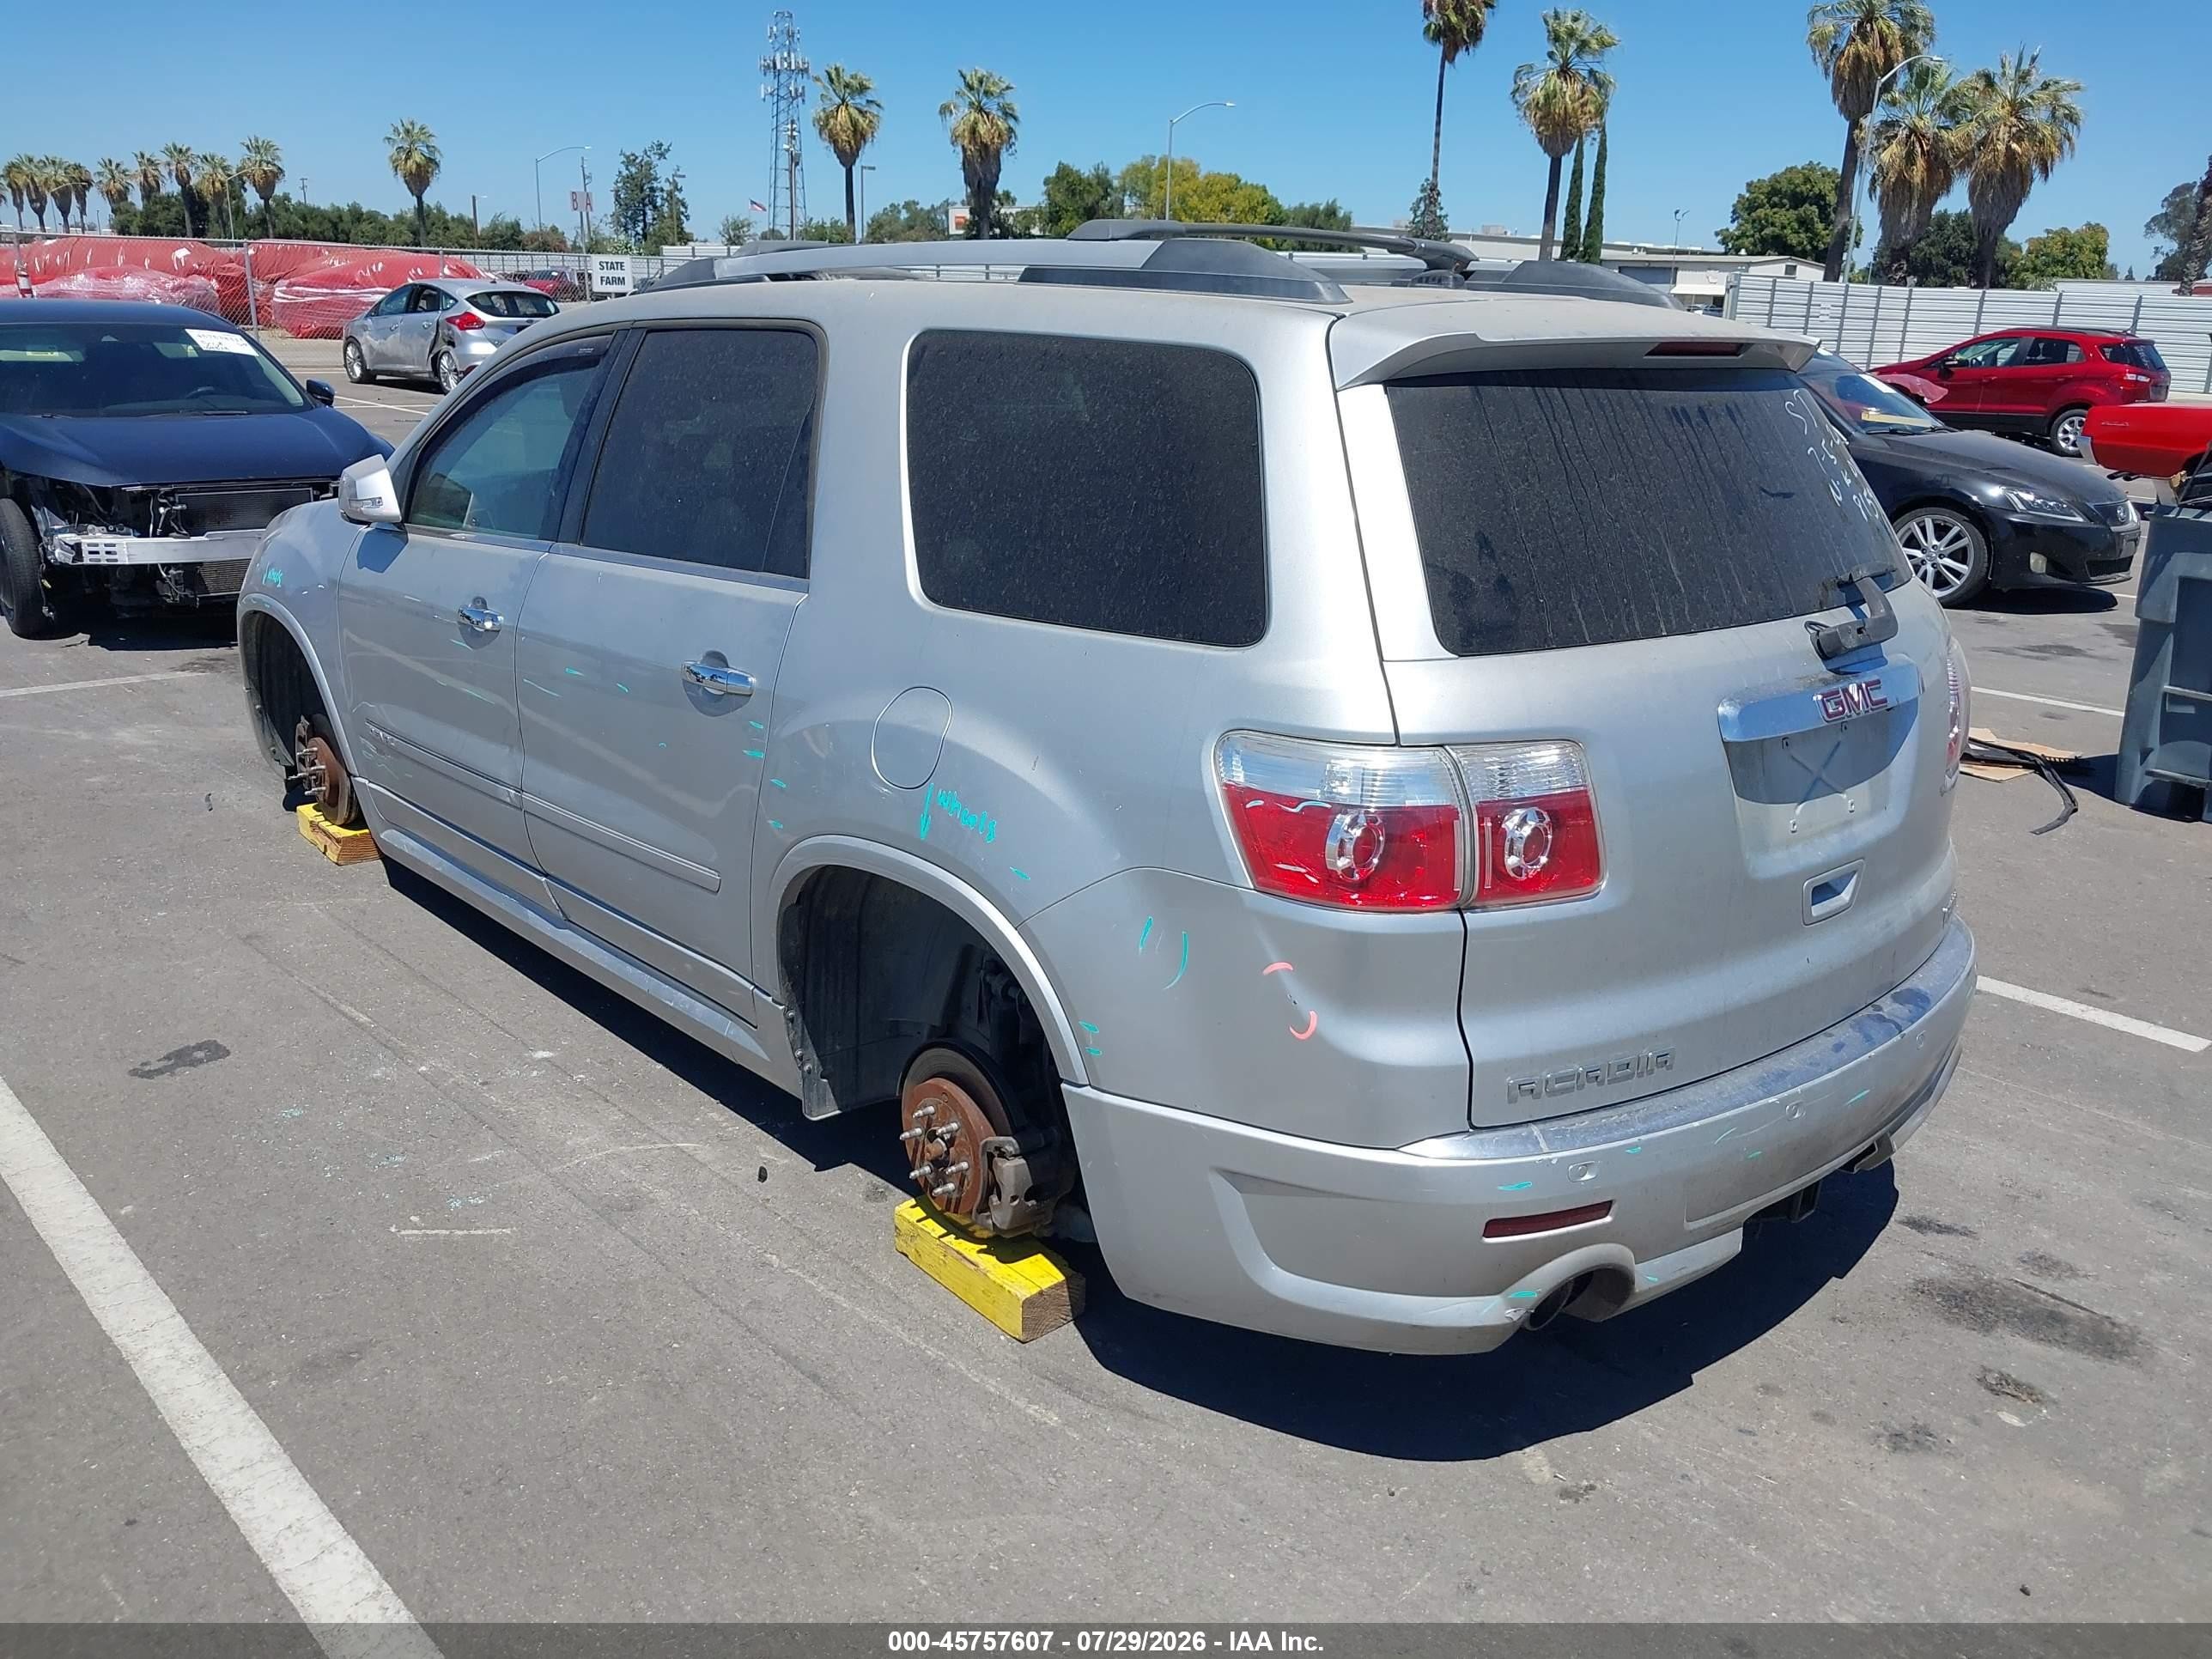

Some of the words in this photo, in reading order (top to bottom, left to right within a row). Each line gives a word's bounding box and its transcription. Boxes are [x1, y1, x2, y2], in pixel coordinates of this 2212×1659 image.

[599, 261, 625, 270] STATE
[600, 276, 625, 286] FARM
[1812, 678, 1888, 722] GMC
[1506, 1046, 1676, 1104] ACADIA
